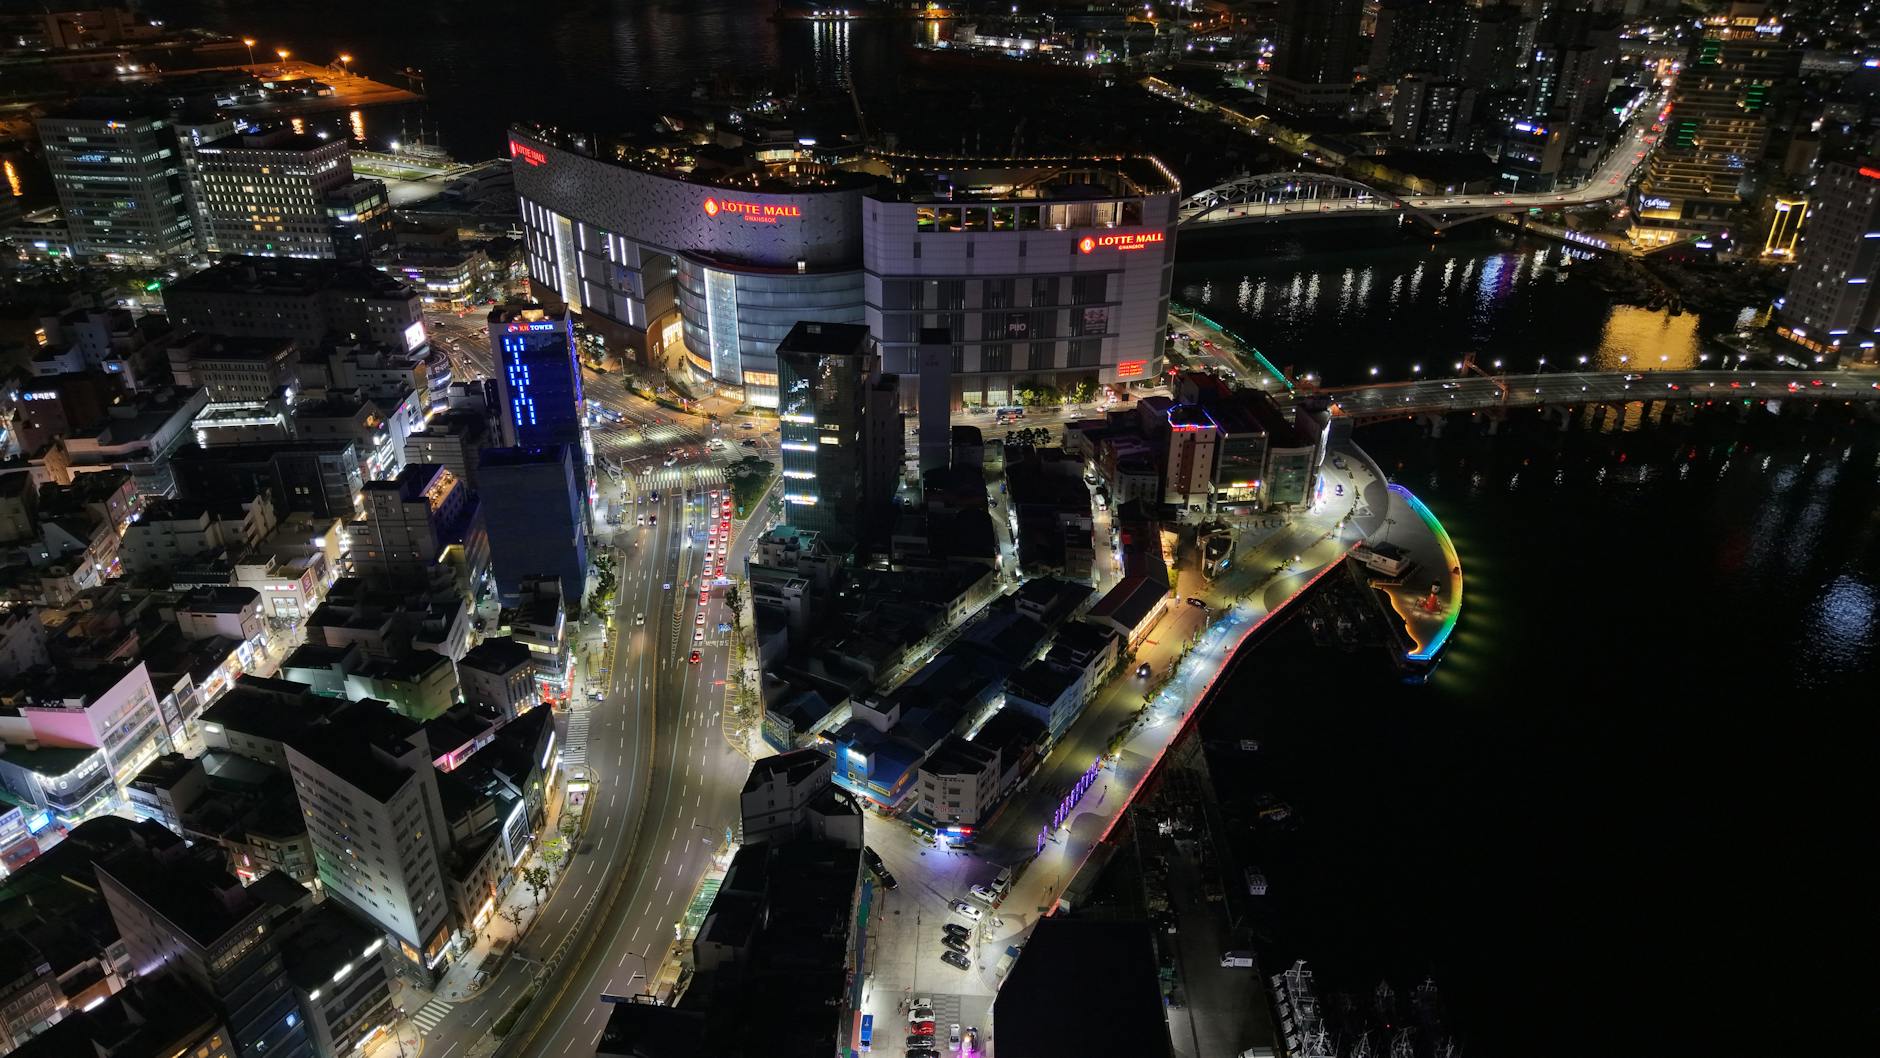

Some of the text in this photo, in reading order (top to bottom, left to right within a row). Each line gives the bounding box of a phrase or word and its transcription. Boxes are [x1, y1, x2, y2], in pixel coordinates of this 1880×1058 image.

[721, 201, 800, 216] LOTTE MALL
[1098, 233, 1164, 246] LOTTE MALL
